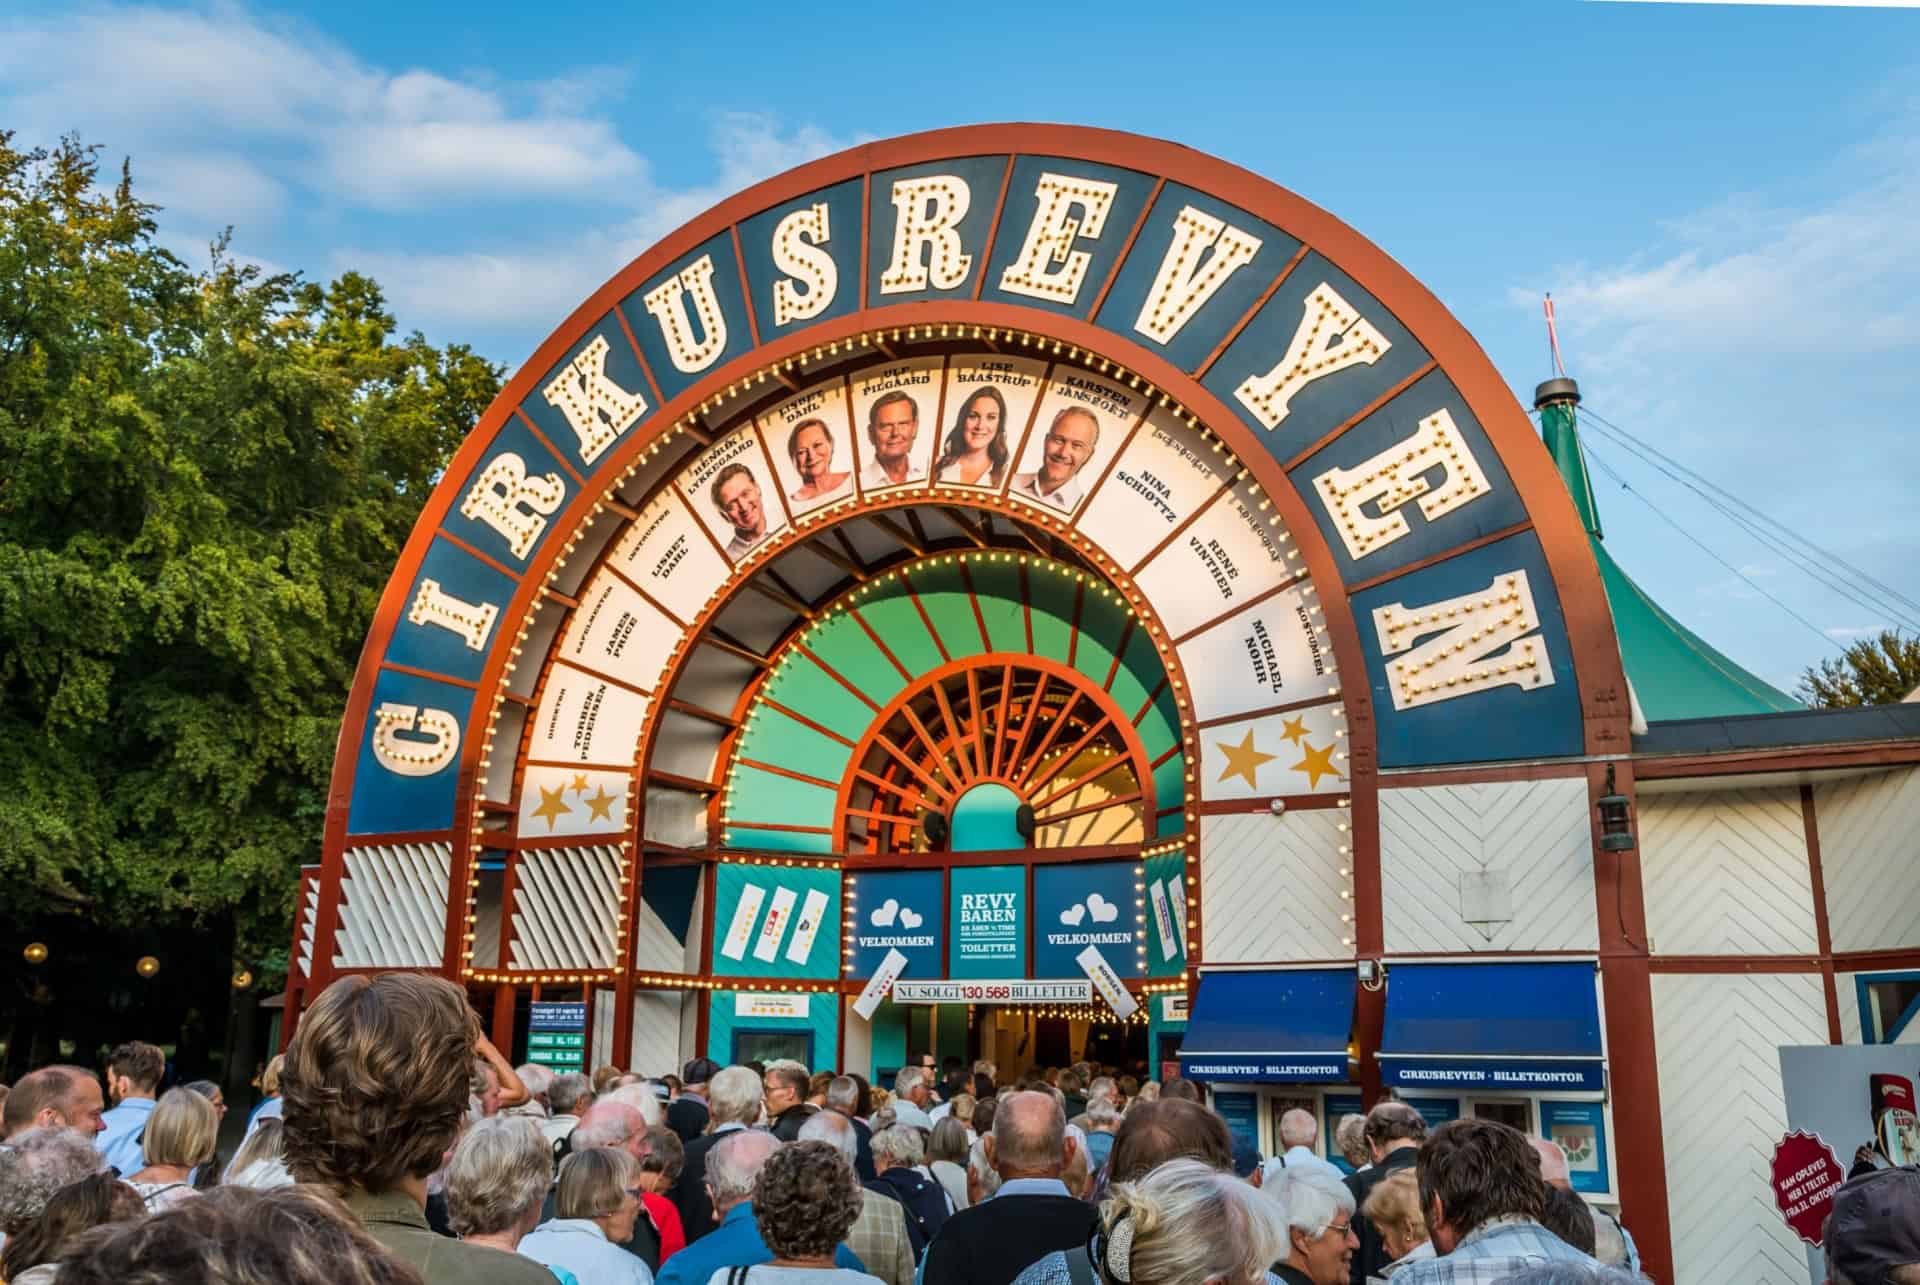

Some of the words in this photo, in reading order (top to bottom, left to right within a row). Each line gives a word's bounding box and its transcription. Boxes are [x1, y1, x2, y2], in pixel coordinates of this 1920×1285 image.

[958, 373, 1031, 388] BAASTRUP
[981, 361, 1014, 372] LISE
[863, 375, 931, 395] PILGAARD
[1065, 376, 1131, 406] KARSTEN
[786, 402, 820, 424] DAHL
[688, 439, 754, 495] LYKKEGAARD
[694, 438, 737, 476] HENRIK
[372, 172, 1557, 778] CIRKUSREVYEN
[1140, 470, 1171, 499] NINA
[652, 534, 685, 577] LISBET
[662, 548, 688, 579] DAHL
[1189, 536, 1233, 600] VINTHER
[606, 612, 631, 655] JAMES
[613, 617, 638, 658] PRICE
[1252, 619, 1282, 694] MICHAEL
[573, 691, 594, 749] TORBEN
[581, 683, 607, 760] PEDERSEN
[961, 893, 1016, 909] REVY
[961, 909, 1016, 922] BAREN
[859, 935, 934, 947] VELKOMMEN
[960, 943, 1016, 952] TOILETTER
[1048, 932, 1132, 945] VELKOMMEN
[899, 987, 916, 997] NU
[961, 986, 984, 999] 130
[985, 986, 1010, 999] 568
[1011, 986, 1087, 998] BILLETTER
[1189, 1065, 1259, 1074] CIRKUSREVYEN
[1266, 1066, 1339, 1075] BILLETKONTOR
[1399, 1069, 1486, 1081] CIRKUSREVYEN
[1494, 1070, 1584, 1083] BILLETKONTOR
[1780, 1175, 1797, 1191] KAN
[1795, 1158, 1827, 1182] OPLEVES
[1787, 1188, 1803, 1202] HER
[1806, 1171, 1830, 1192] TELTET
[1785, 1205, 1801, 1218] FRA
